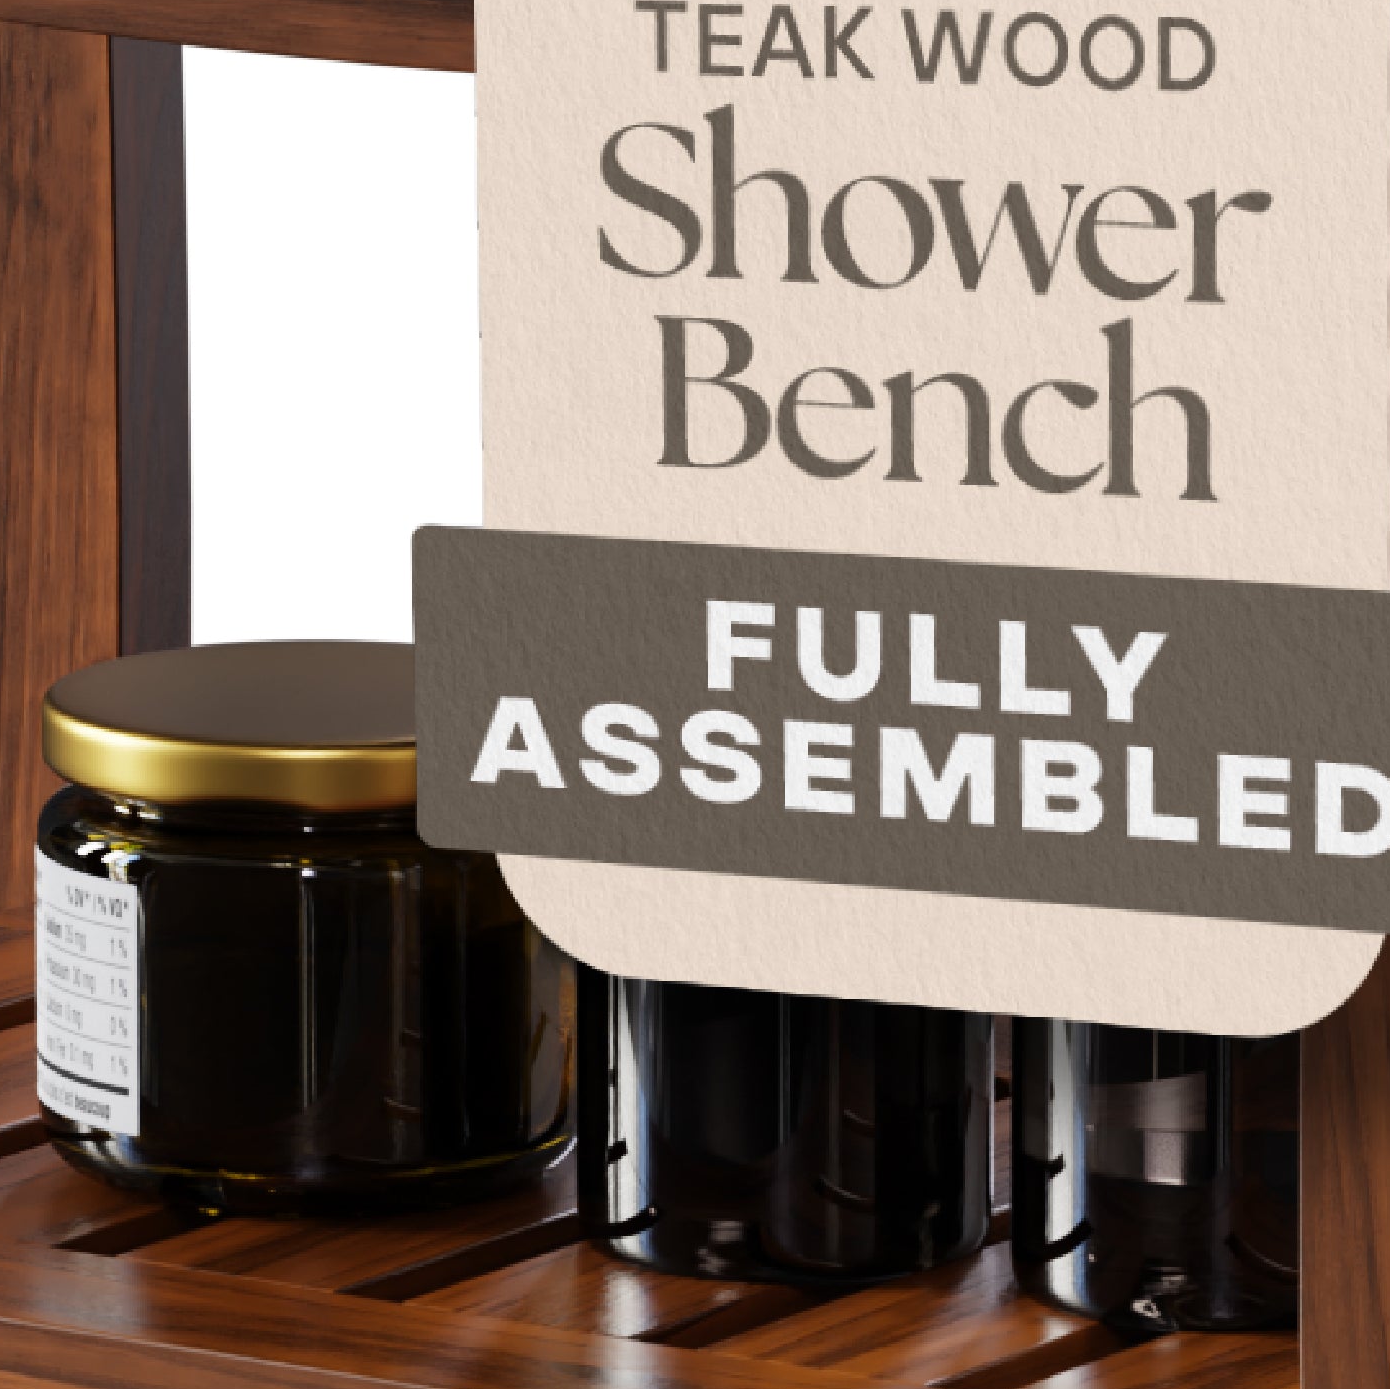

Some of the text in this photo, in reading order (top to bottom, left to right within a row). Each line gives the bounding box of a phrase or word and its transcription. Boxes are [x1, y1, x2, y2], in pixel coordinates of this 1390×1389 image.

[635, 0, 1217, 93] TEAK WOOD
[598, 103, 1273, 303] Shower
[653, 314, 1219, 504] Bench
[705, 599, 1168, 724] FULLY
